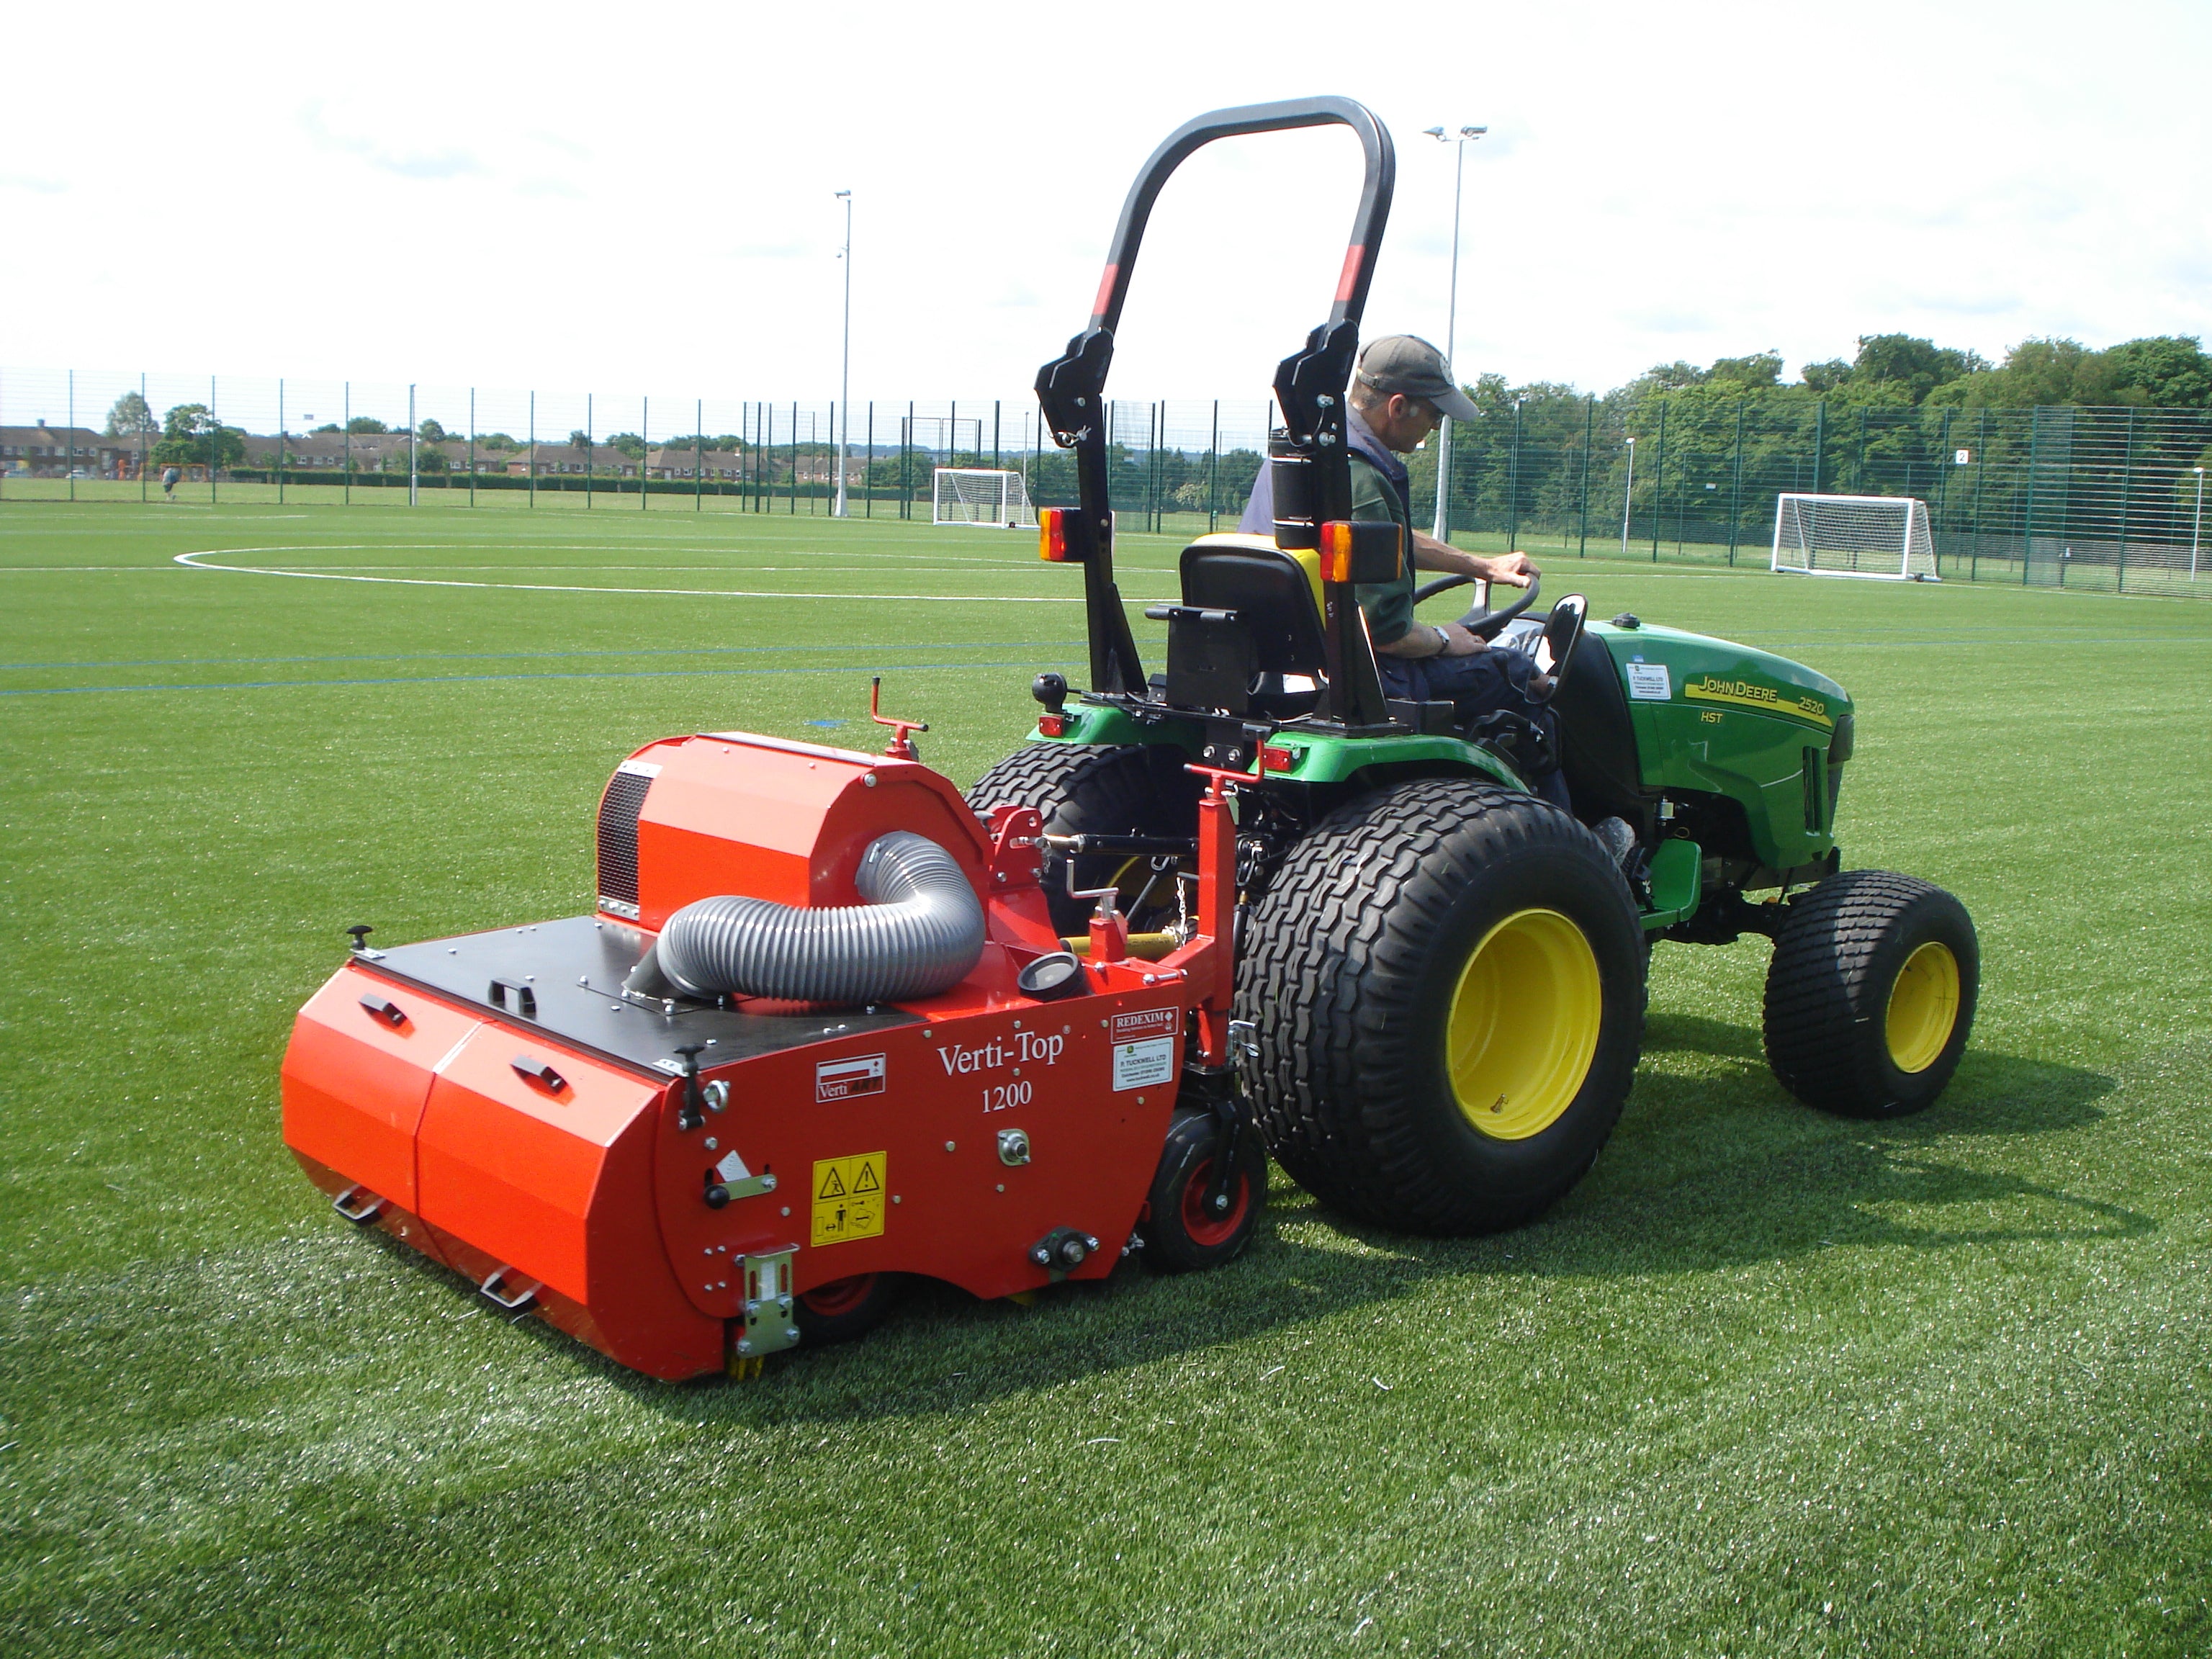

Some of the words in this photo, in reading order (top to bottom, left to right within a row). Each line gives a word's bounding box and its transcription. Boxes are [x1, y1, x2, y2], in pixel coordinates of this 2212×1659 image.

[1959, 452, 1965, 462] 2
[1699, 676, 1734, 695] JOHN
[1736, 681, 1778, 702] DEERE
[1799, 696, 1825, 715] 2520
[1701, 711, 1723, 724] HST
[1117, 1012, 1164, 1028] REDEXIM
[982, 1081, 1032, 1113] 1200
